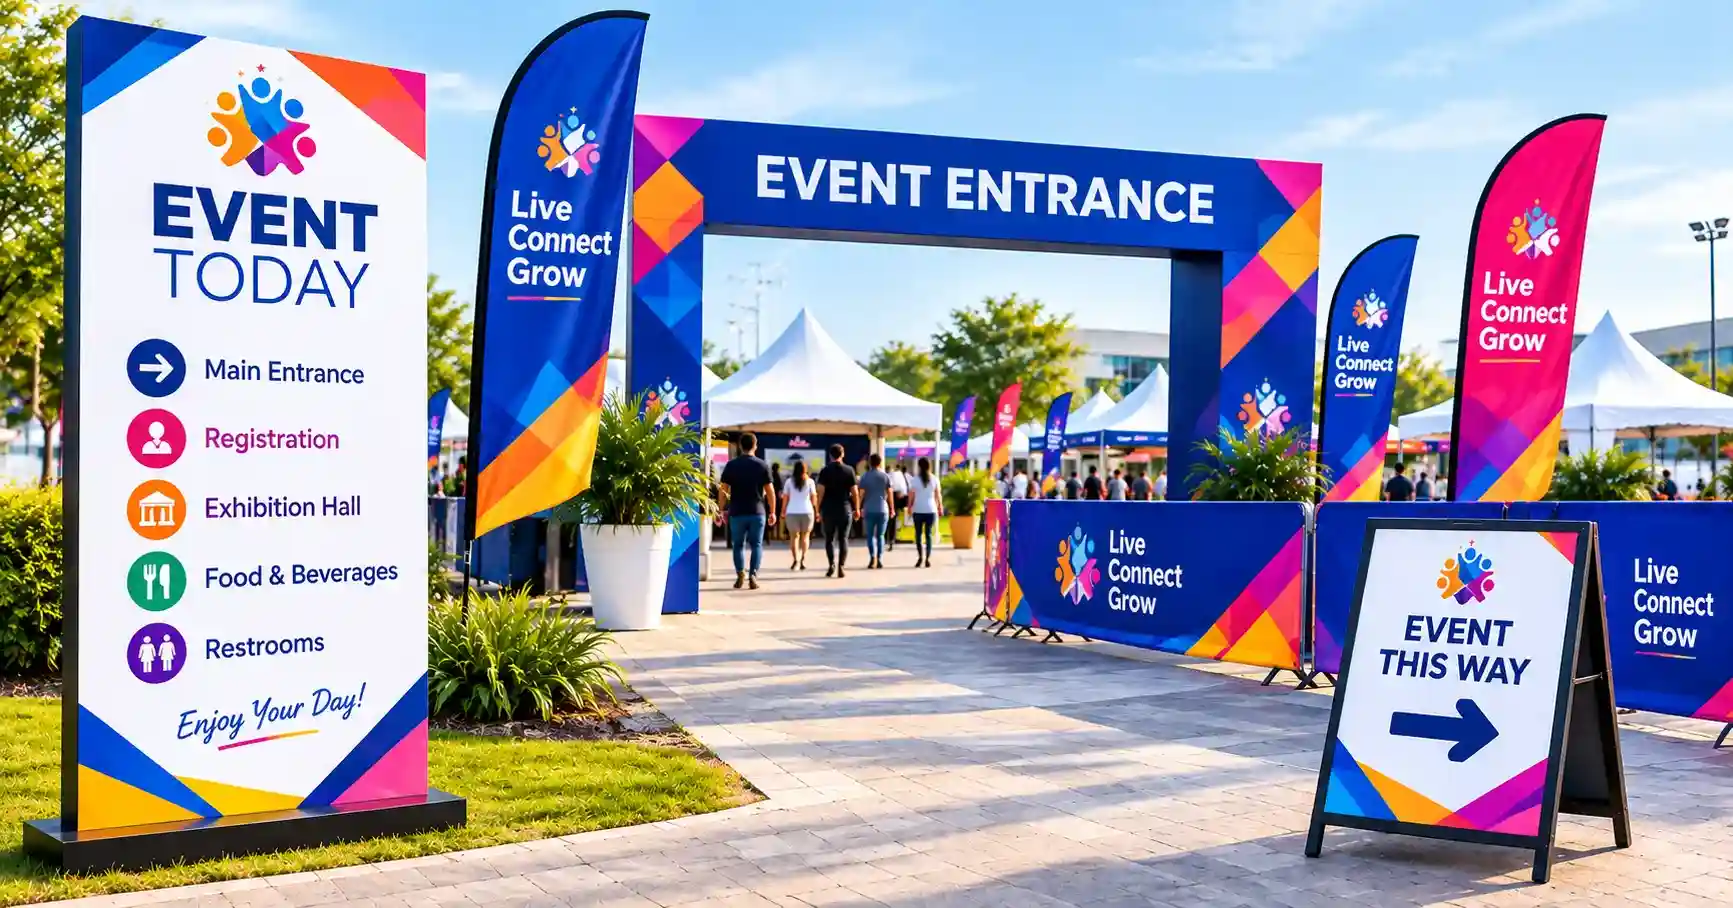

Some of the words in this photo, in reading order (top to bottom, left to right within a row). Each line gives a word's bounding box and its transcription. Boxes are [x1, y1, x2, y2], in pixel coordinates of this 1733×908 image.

[758, 154, 931, 207] EVENT
[947, 167, 1214, 224] ENTRANCE
[152, 182, 378, 252] EVENT
[511, 190, 573, 221] Live
[508, 223, 613, 256] Connect
[153, 247, 370, 309] TODAY
[507, 256, 587, 288] Grow
[1483, 271, 1534, 296] Live
[1480, 299, 1568, 325] Connect
[1337, 335, 1370, 353] Live
[1479, 326, 1546, 352] Grow
[205, 358, 261, 381] Main
[268, 361, 365, 384] Entrance
[1335, 354, 1394, 373] Connect
[1334, 372, 1377, 391] Grow
[205, 427, 340, 454] Registration
[205, 496, 316, 519] Exhibition
[322, 495, 361, 517] Hall
[1109, 529, 1146, 556] Live
[205, 565, 263, 589] Food
[268, 565, 286, 586] &
[292, 563, 399, 587] Beverages
[1108, 558, 1183, 589] Connect
[1634, 557, 1679, 585] Live
[1108, 586, 1157, 615] Grow
[1634, 588, 1714, 617] Connect
[1404, 614, 1514, 647] EVENT
[1634, 618, 1697, 648] Grow
[205, 635, 325, 660] Restrooms
[1379, 648, 1448, 680] THIS
[1457, 654, 1532, 686] WAY
[176, 709, 245, 745] Enjoy
[251, 697, 305, 730] Your
[311, 681, 367, 717] Day!
